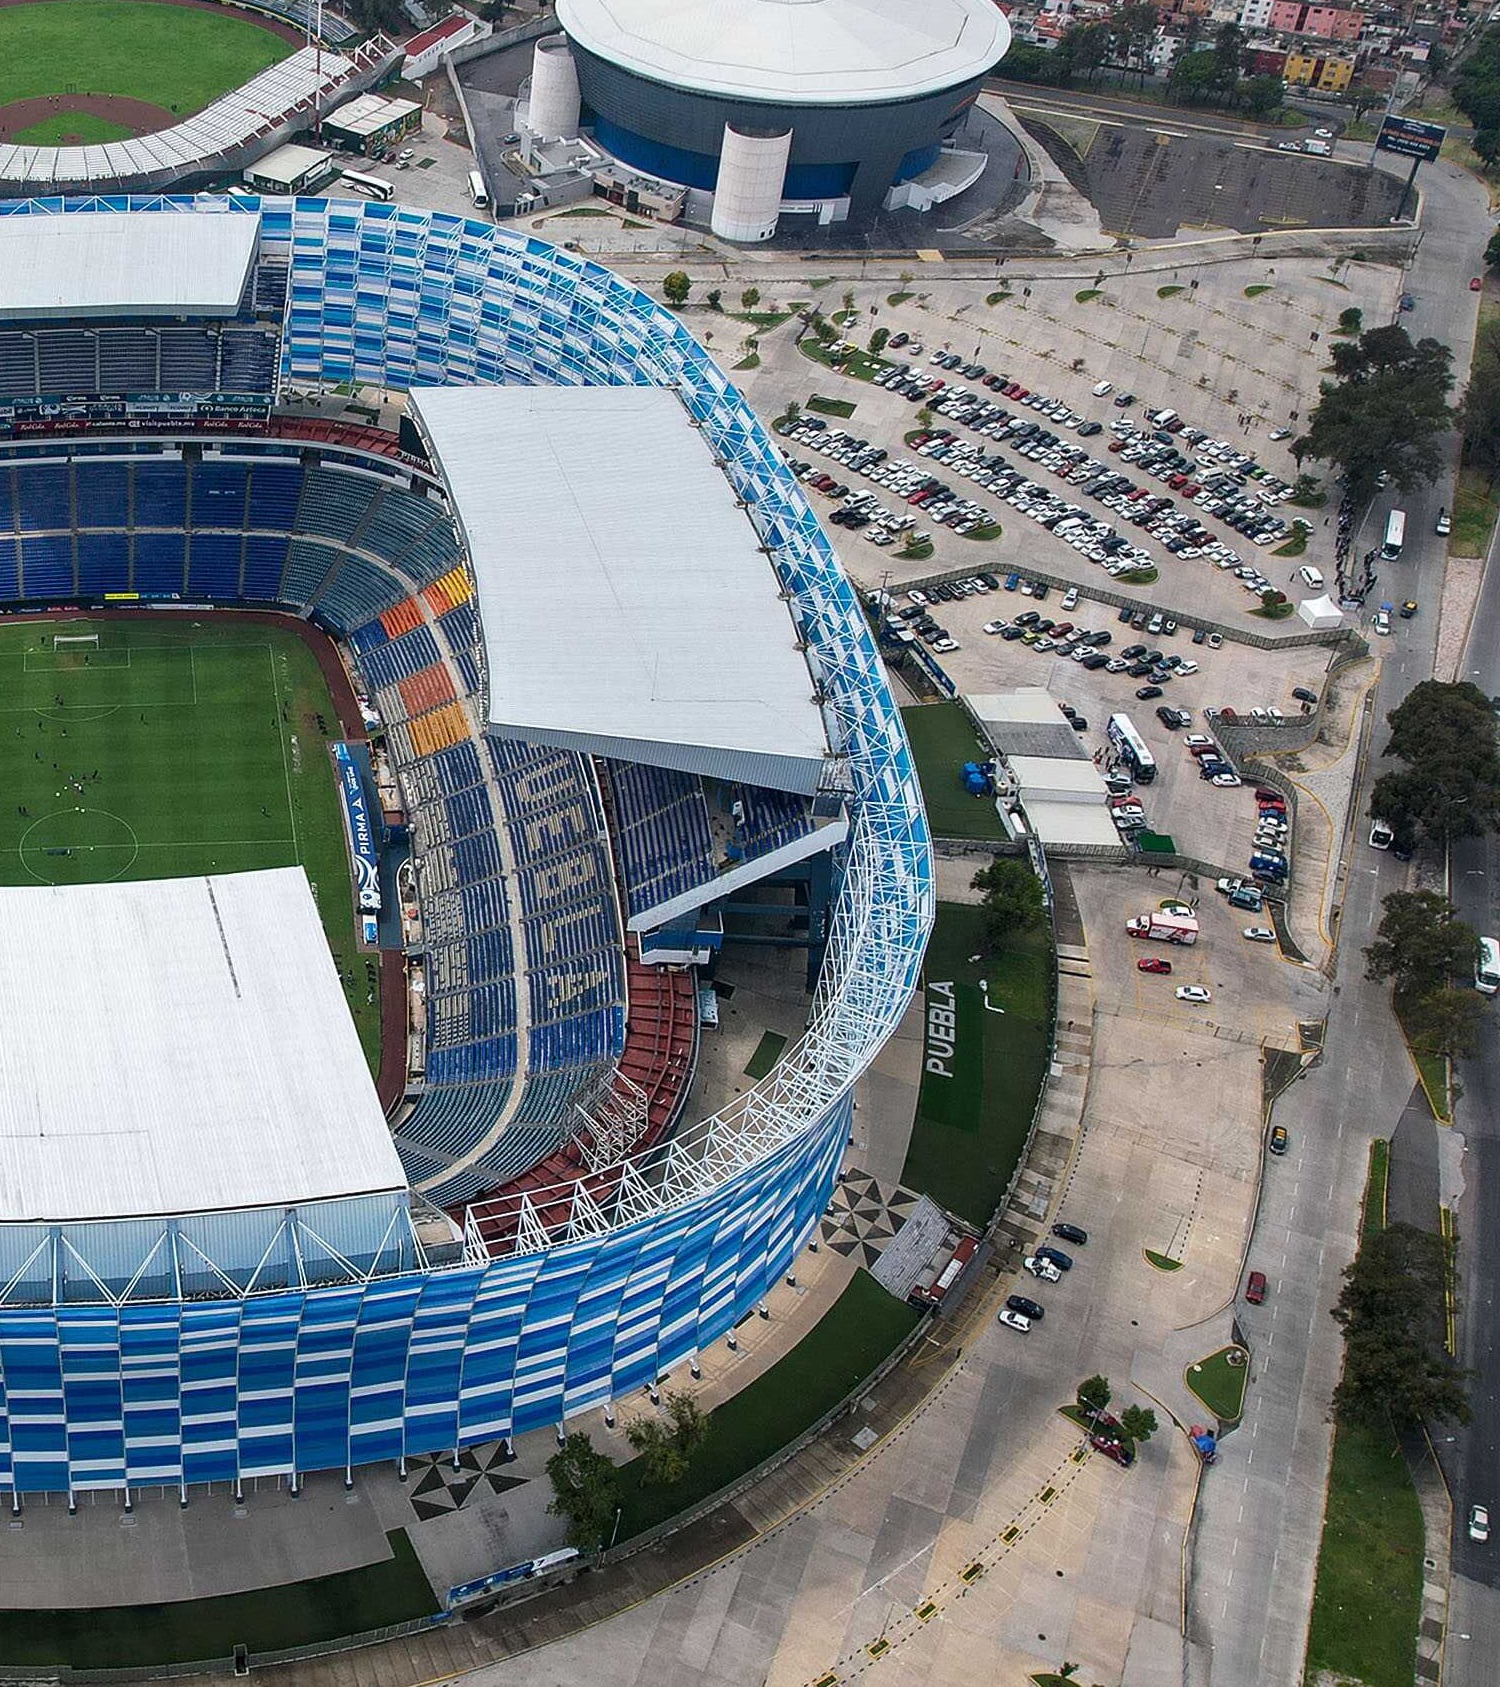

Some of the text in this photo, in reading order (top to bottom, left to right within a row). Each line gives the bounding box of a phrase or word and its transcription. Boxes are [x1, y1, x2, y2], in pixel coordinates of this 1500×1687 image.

[141, 420, 195, 428] visitpuebla.mx
[215, 404, 266, 414] Banco Azteca
[355, 812, 371, 855] PIRMA
[516, 742, 609, 1010] UEBLA
[926, 980, 956, 1078] PUEBLA
